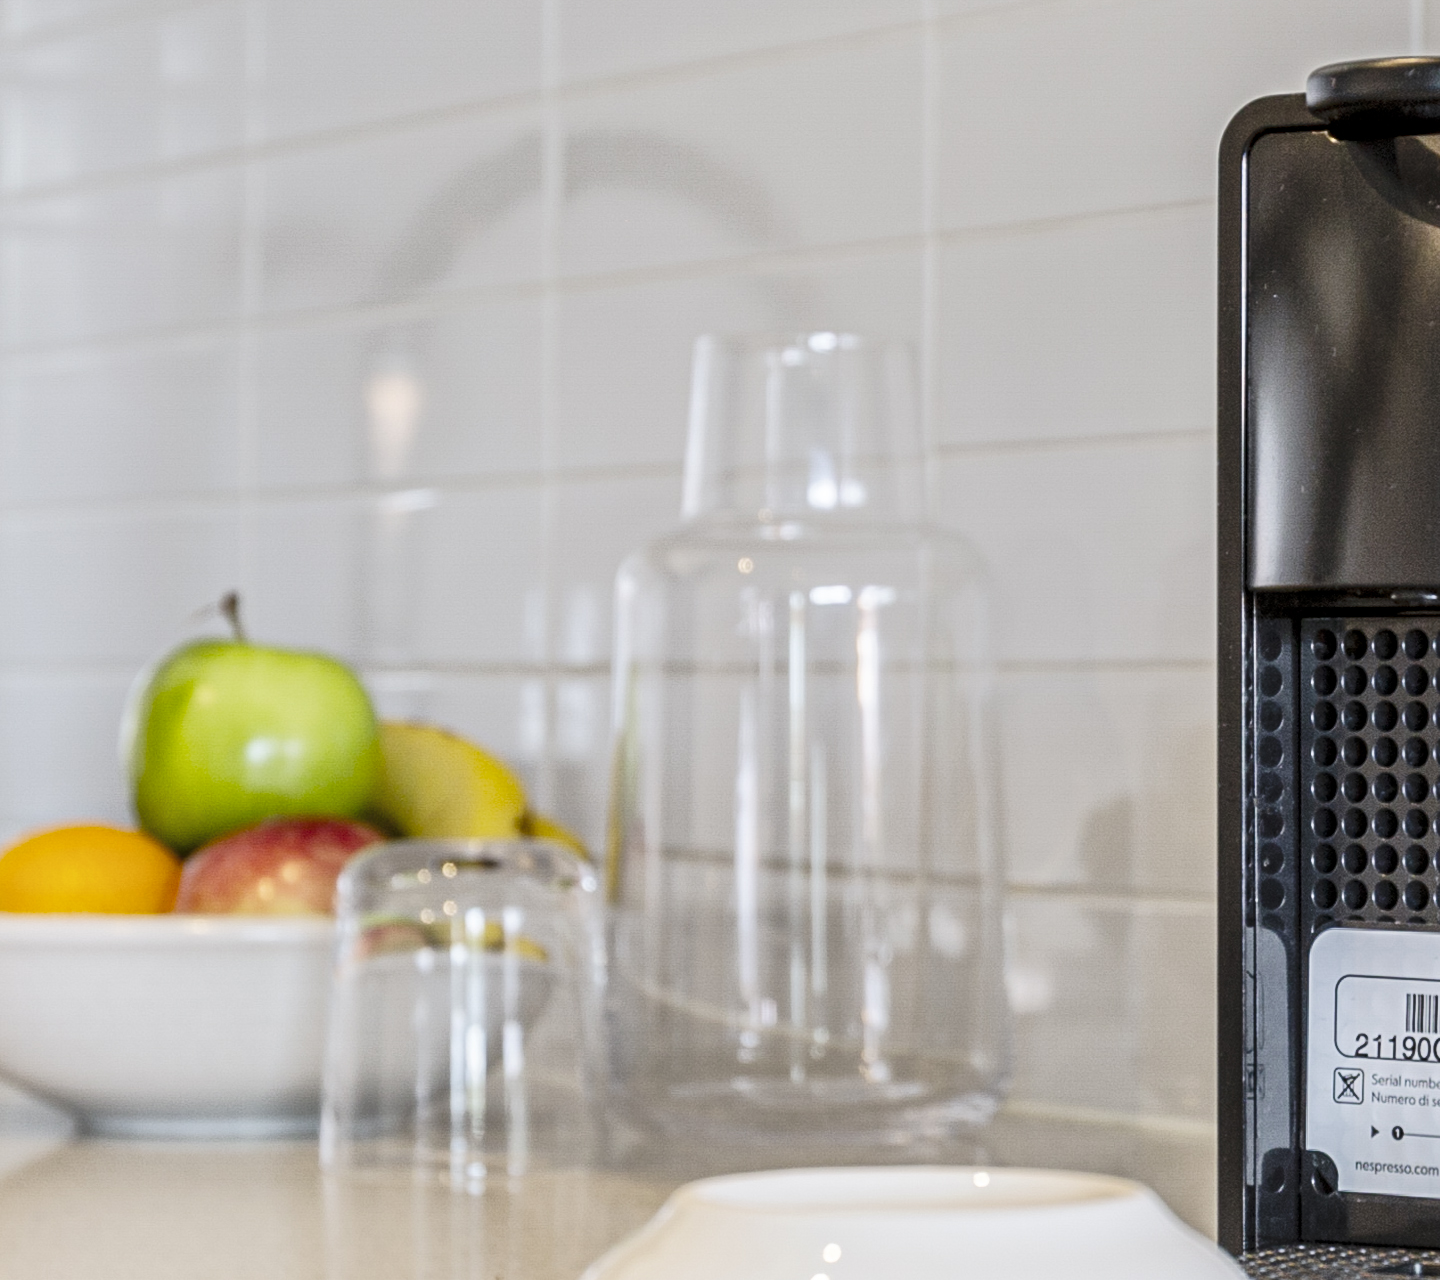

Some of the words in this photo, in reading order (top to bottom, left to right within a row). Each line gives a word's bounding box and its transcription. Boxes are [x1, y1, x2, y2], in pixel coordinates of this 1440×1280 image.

[1371, 1073, 1401, 1086] Serial
[1371, 1091, 1416, 1105] Numero
[1418, 1094, 1429, 1106] di
[1355, 1161, 1439, 1176] nespresso.com
